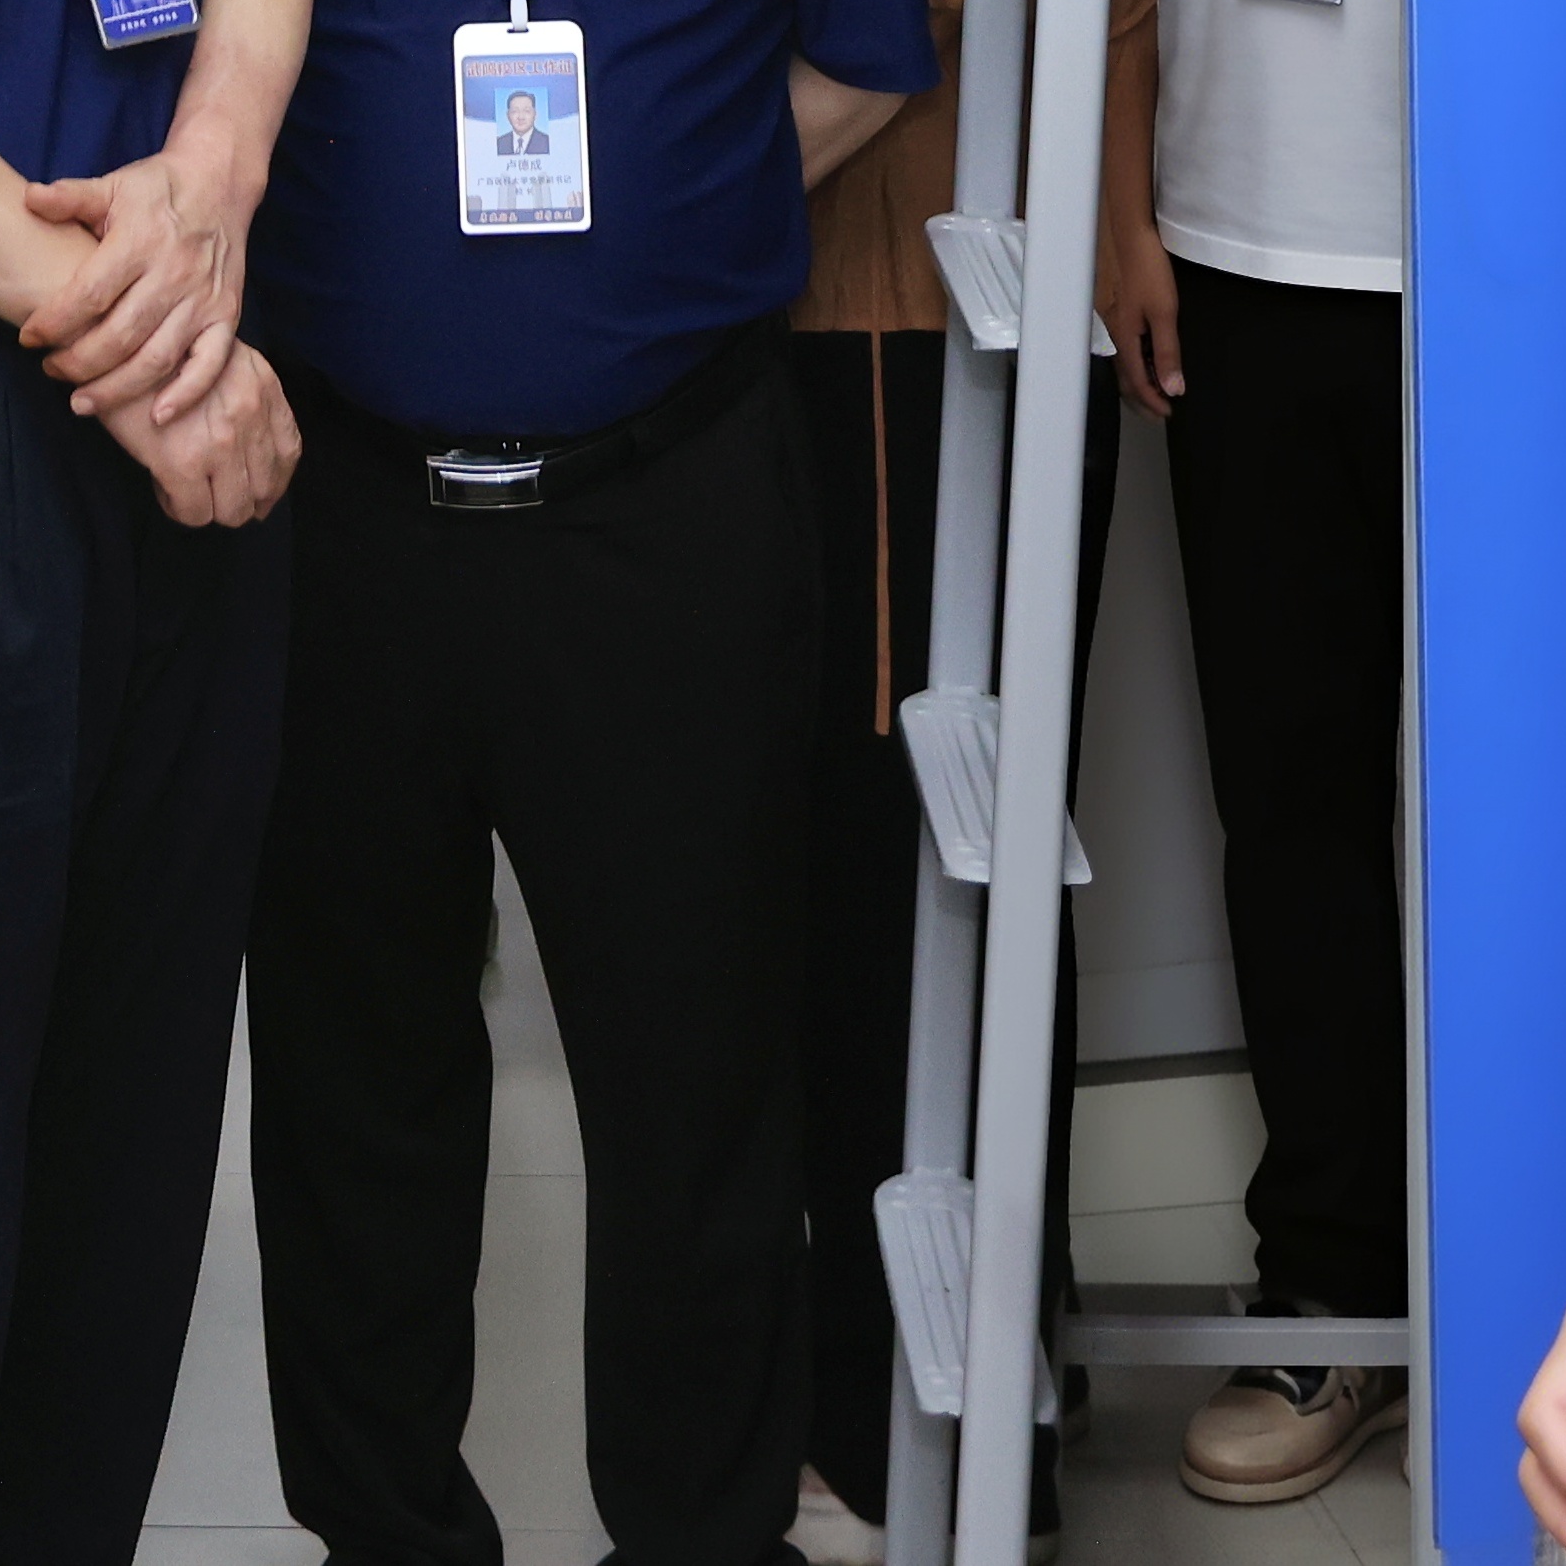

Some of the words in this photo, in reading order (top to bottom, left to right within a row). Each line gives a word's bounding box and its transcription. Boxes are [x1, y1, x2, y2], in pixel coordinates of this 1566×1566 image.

[466, 59, 575, 78] 武鸣校区工作证
[506, 158, 542, 172] 卢德成
